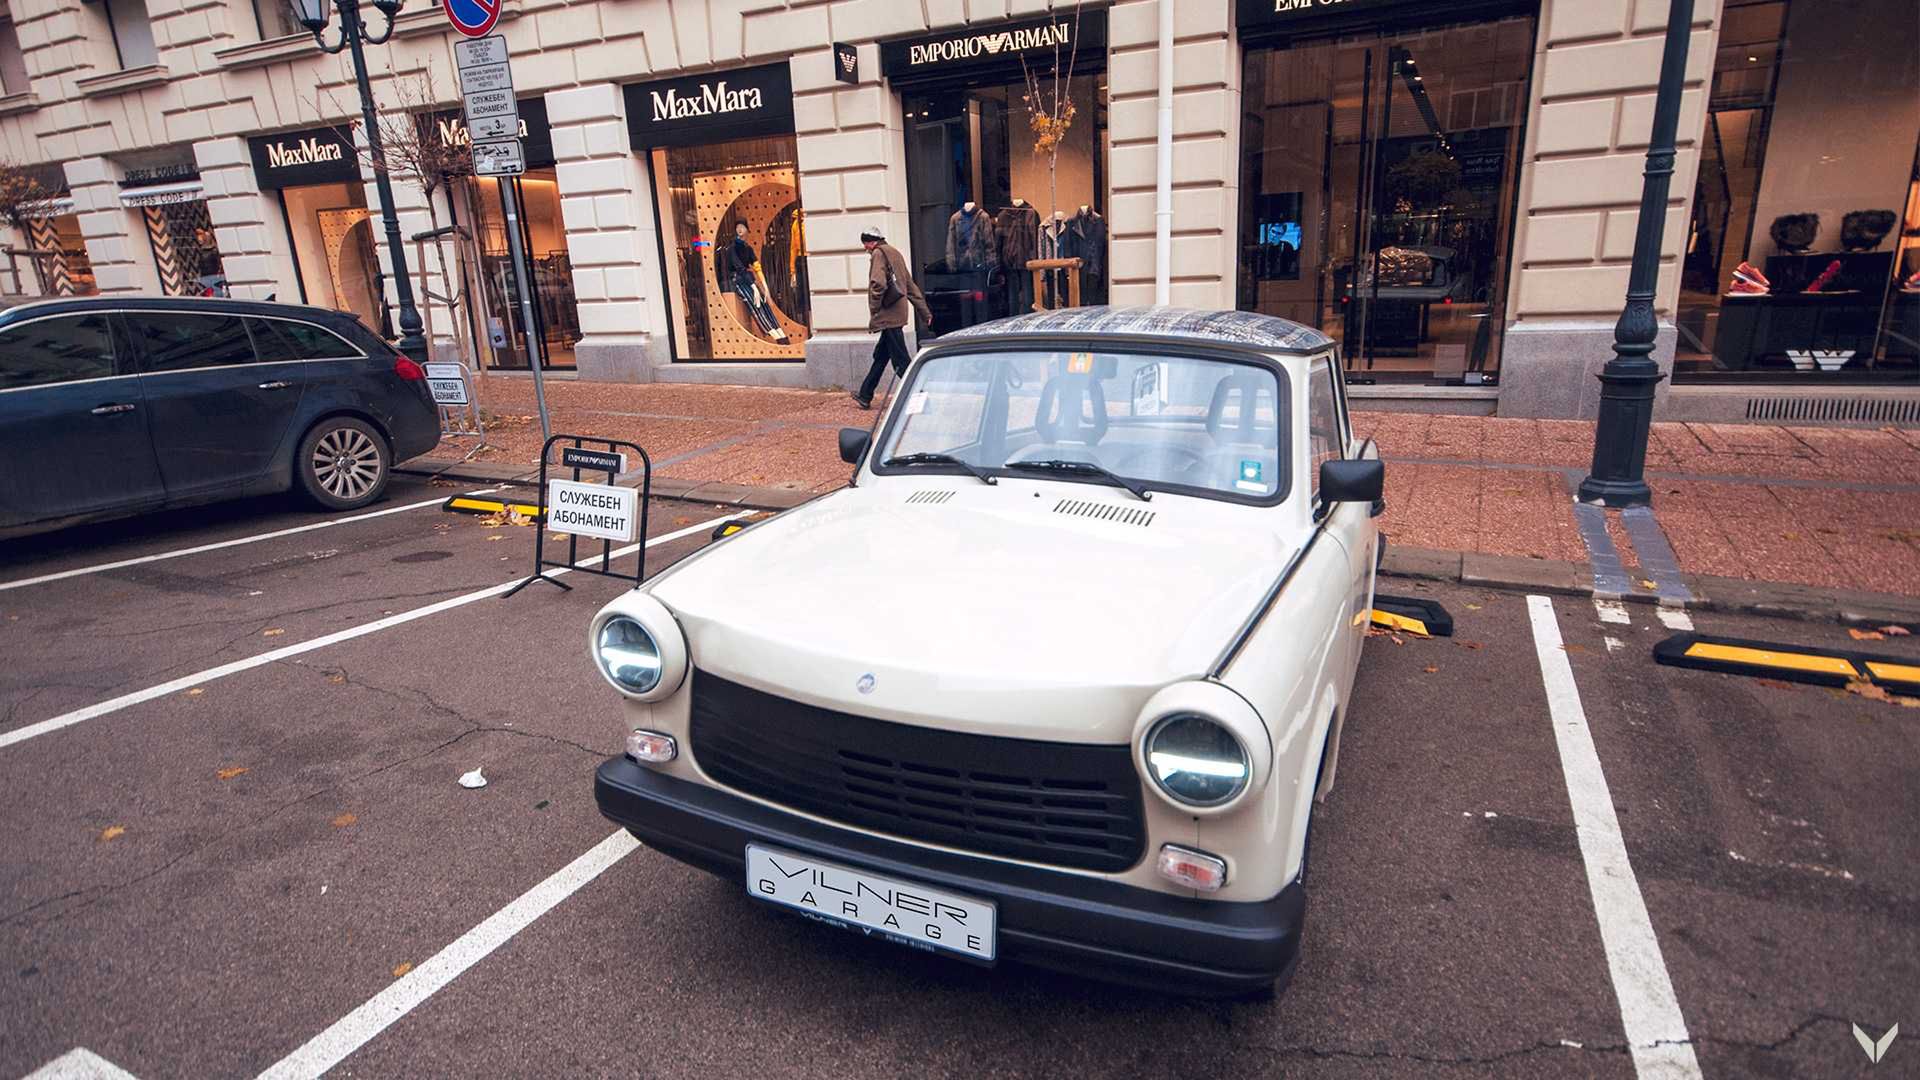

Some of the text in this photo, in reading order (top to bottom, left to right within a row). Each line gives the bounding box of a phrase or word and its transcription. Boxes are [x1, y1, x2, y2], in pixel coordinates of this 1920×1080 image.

[910, 23, 1069, 65] EMPORIO ARMANI
[472, 93, 506, 105] СЛУЖЕБЕН
[650, 81, 763, 122] MaxMara
[494, 119, 501, 130] 3
[265, 137, 343, 168] MaxMara
[559, 490, 621, 511] СЛУЖЕБЕН
[553, 509, 626, 531] АБОНАМЕНТ
[768, 857, 968, 927] VILNER
[758, 878, 982, 951] GARAGE
